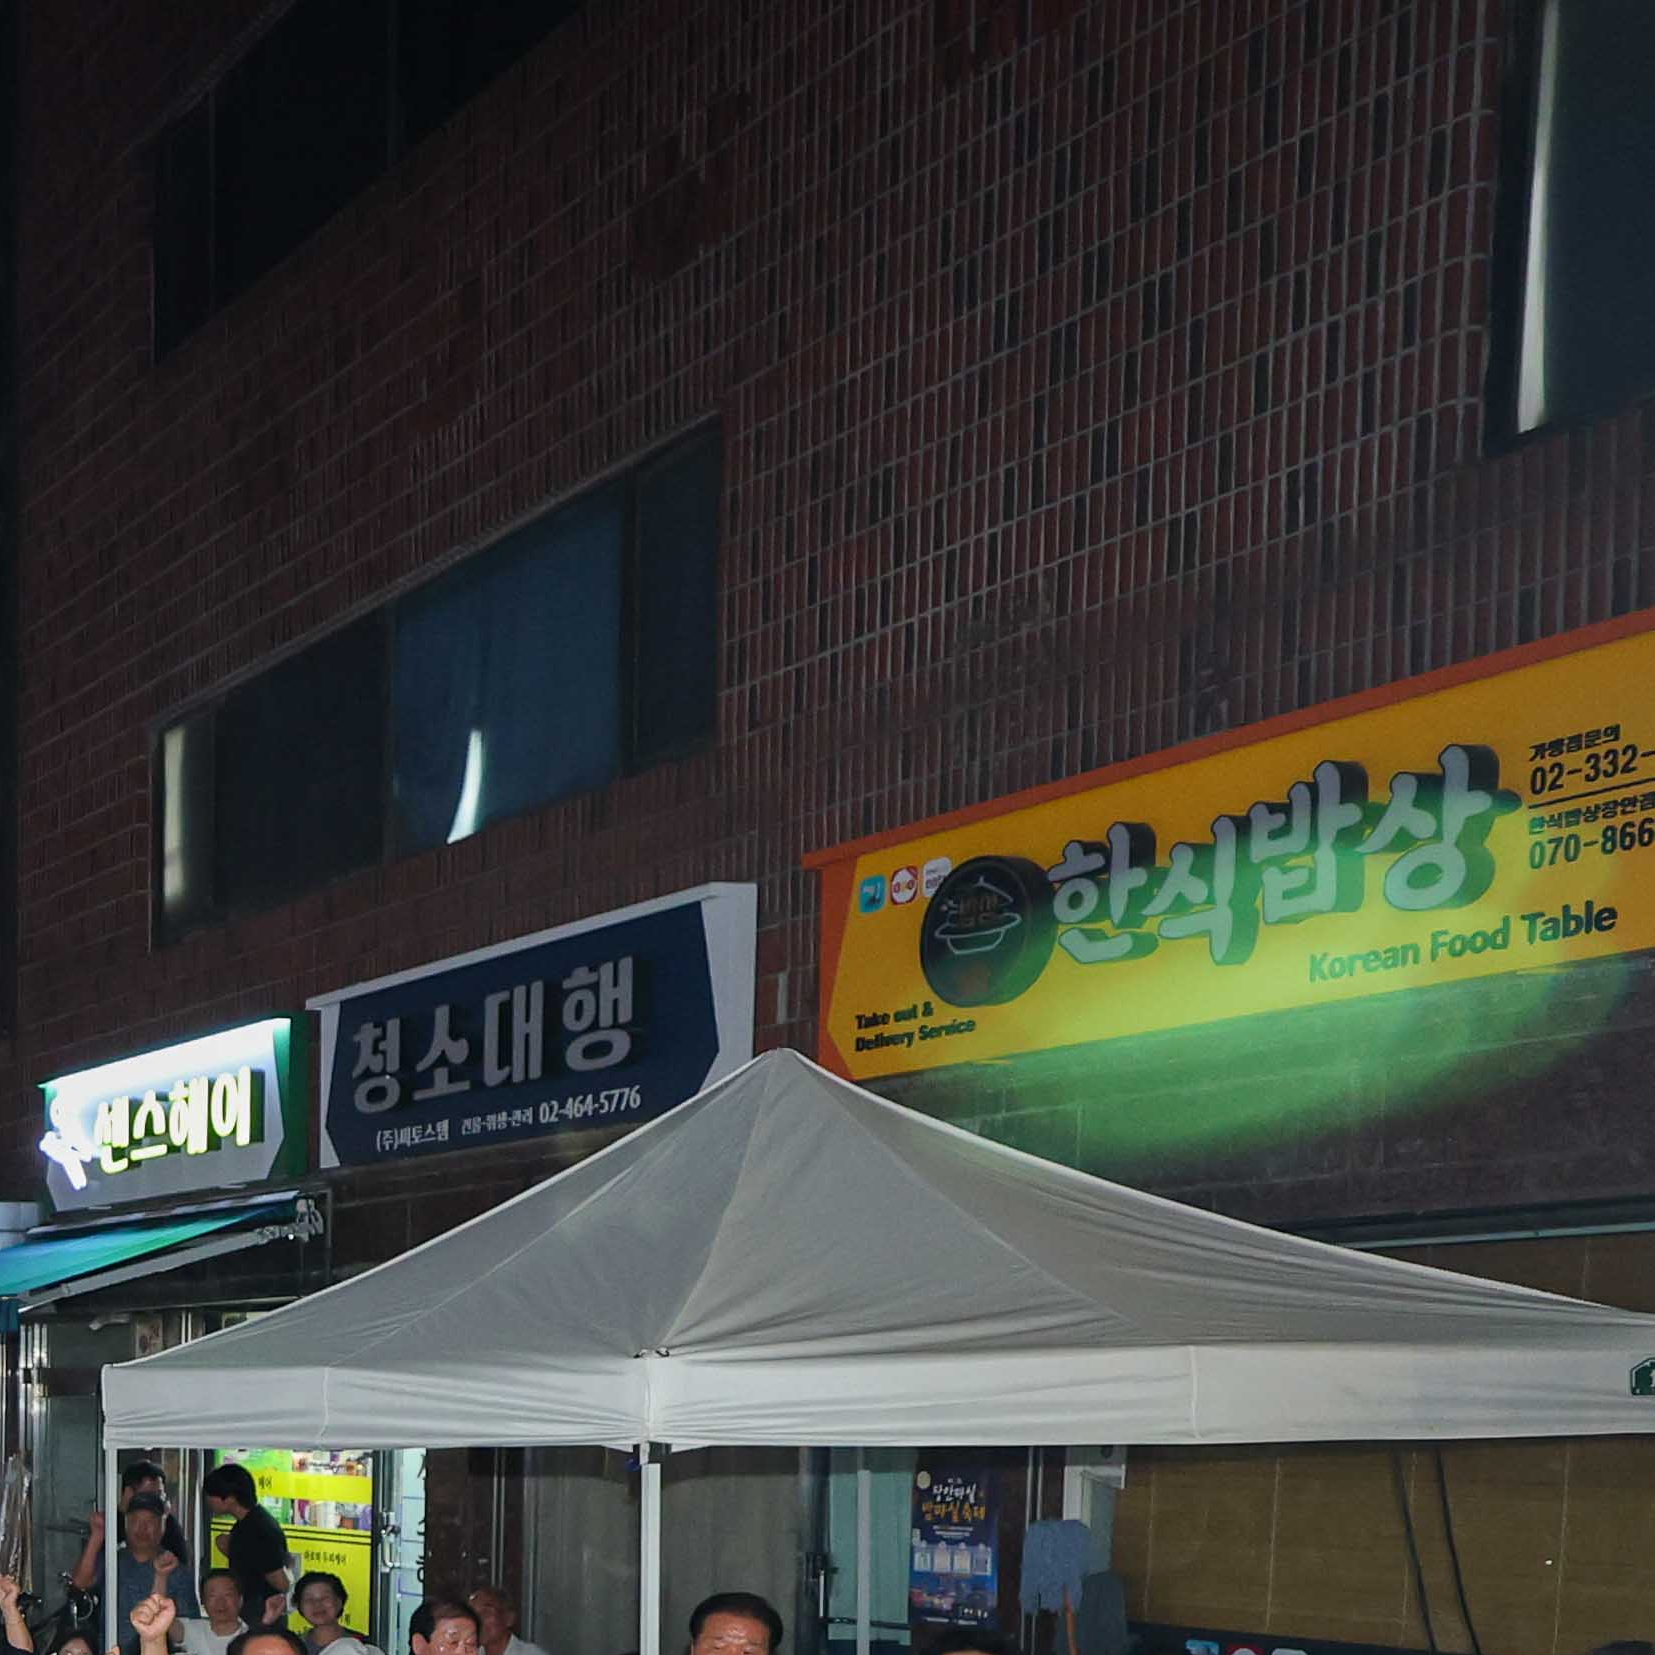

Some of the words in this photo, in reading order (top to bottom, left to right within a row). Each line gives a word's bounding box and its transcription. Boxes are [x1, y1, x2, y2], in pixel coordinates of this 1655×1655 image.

[1050, 744, 1509, 965] 한식밥상
[1309, 941, 1420, 983] Korean
[1430, 927, 1509, 967] Food
[1520, 901, 1617, 948] Table
[351, 954, 635, 1115] 청소대행
[855, 1012, 890, 1030] Take
[893, 1004, 917, 1024] out
[922, 1001, 934, 1017] &
[855, 1030, 915, 1052] Delivery
[918, 1019, 977, 1041] Service
[539, 1085, 641, 1124] 02-464-5776
